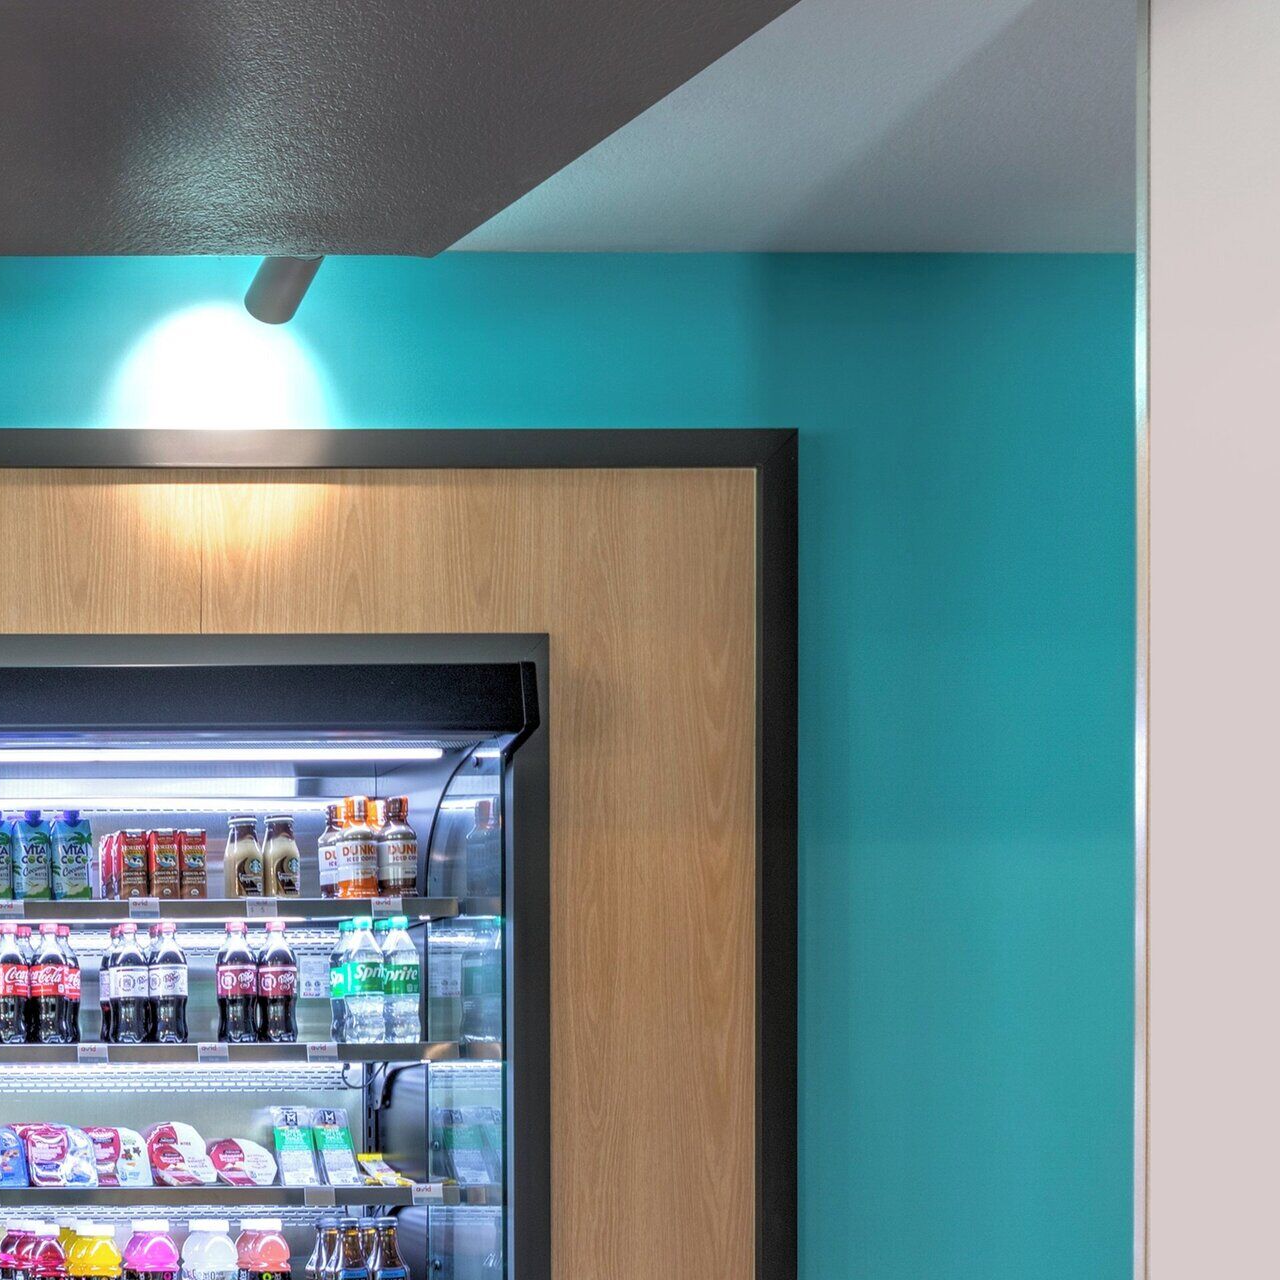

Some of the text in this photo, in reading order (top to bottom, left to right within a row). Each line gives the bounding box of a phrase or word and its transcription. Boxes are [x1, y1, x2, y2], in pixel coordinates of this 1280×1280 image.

[23, 845, 46, 856] VITA
[62, 845, 85, 856] VITA
[342, 843, 376, 857] DUNK
[60, 856, 89, 865] COCO
[384, 965, 418, 985] prite
